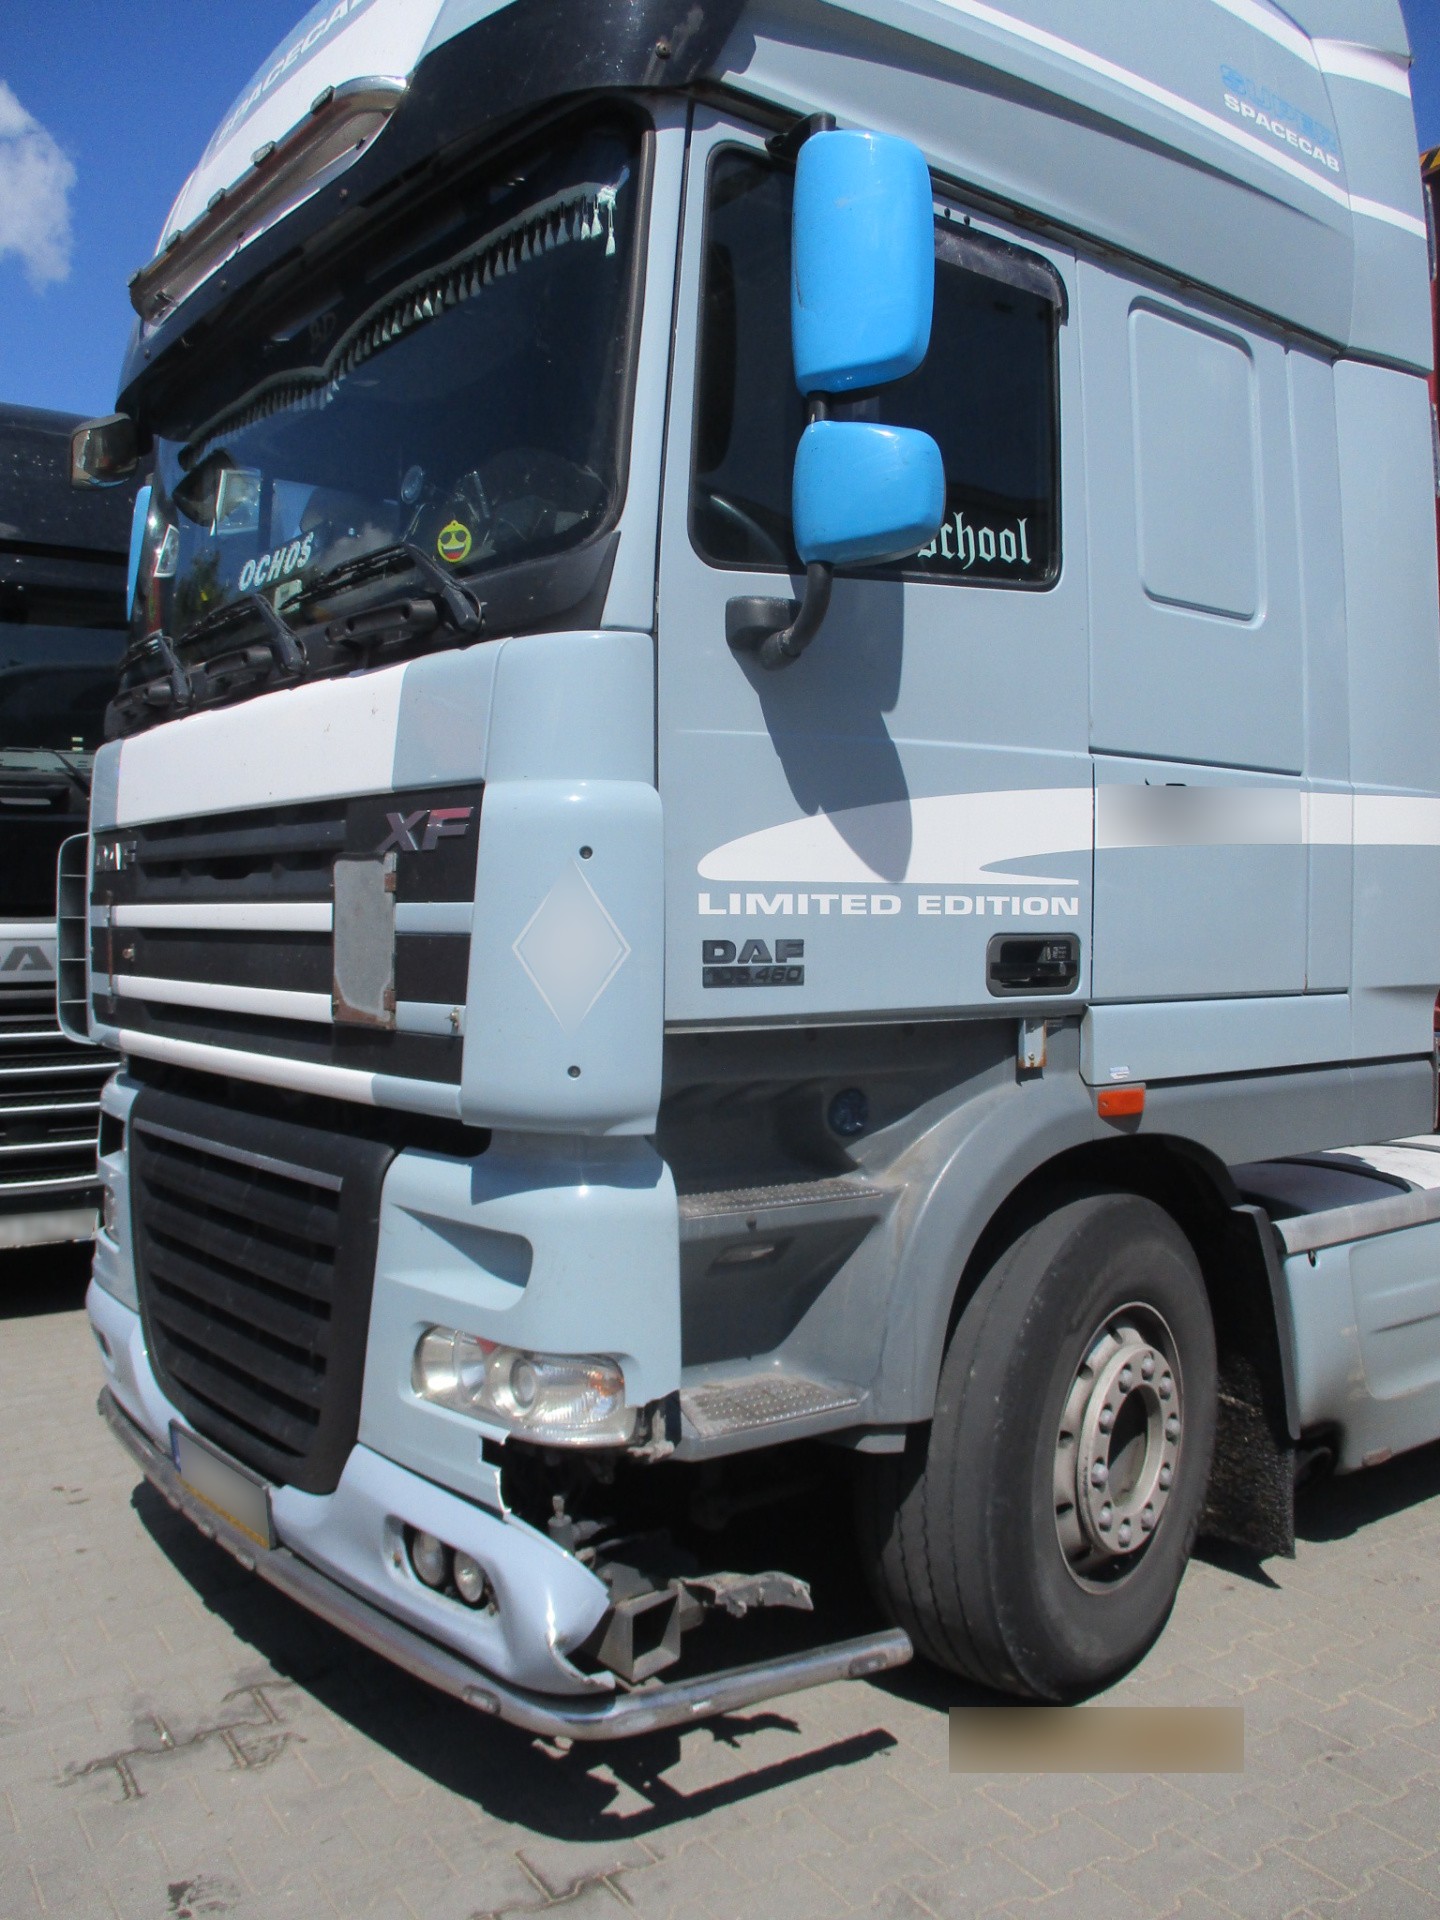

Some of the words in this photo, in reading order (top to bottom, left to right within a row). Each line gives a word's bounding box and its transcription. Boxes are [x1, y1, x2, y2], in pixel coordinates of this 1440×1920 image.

[1223, 93, 1340, 173] SPACECAB
[238, 531, 314, 592] OCHOS
[374, 806, 474, 855] XF
[698, 893, 902, 915] LIMITED
[917, 895, 1079, 916] EDITION
[702, 939, 805, 964] DAF
